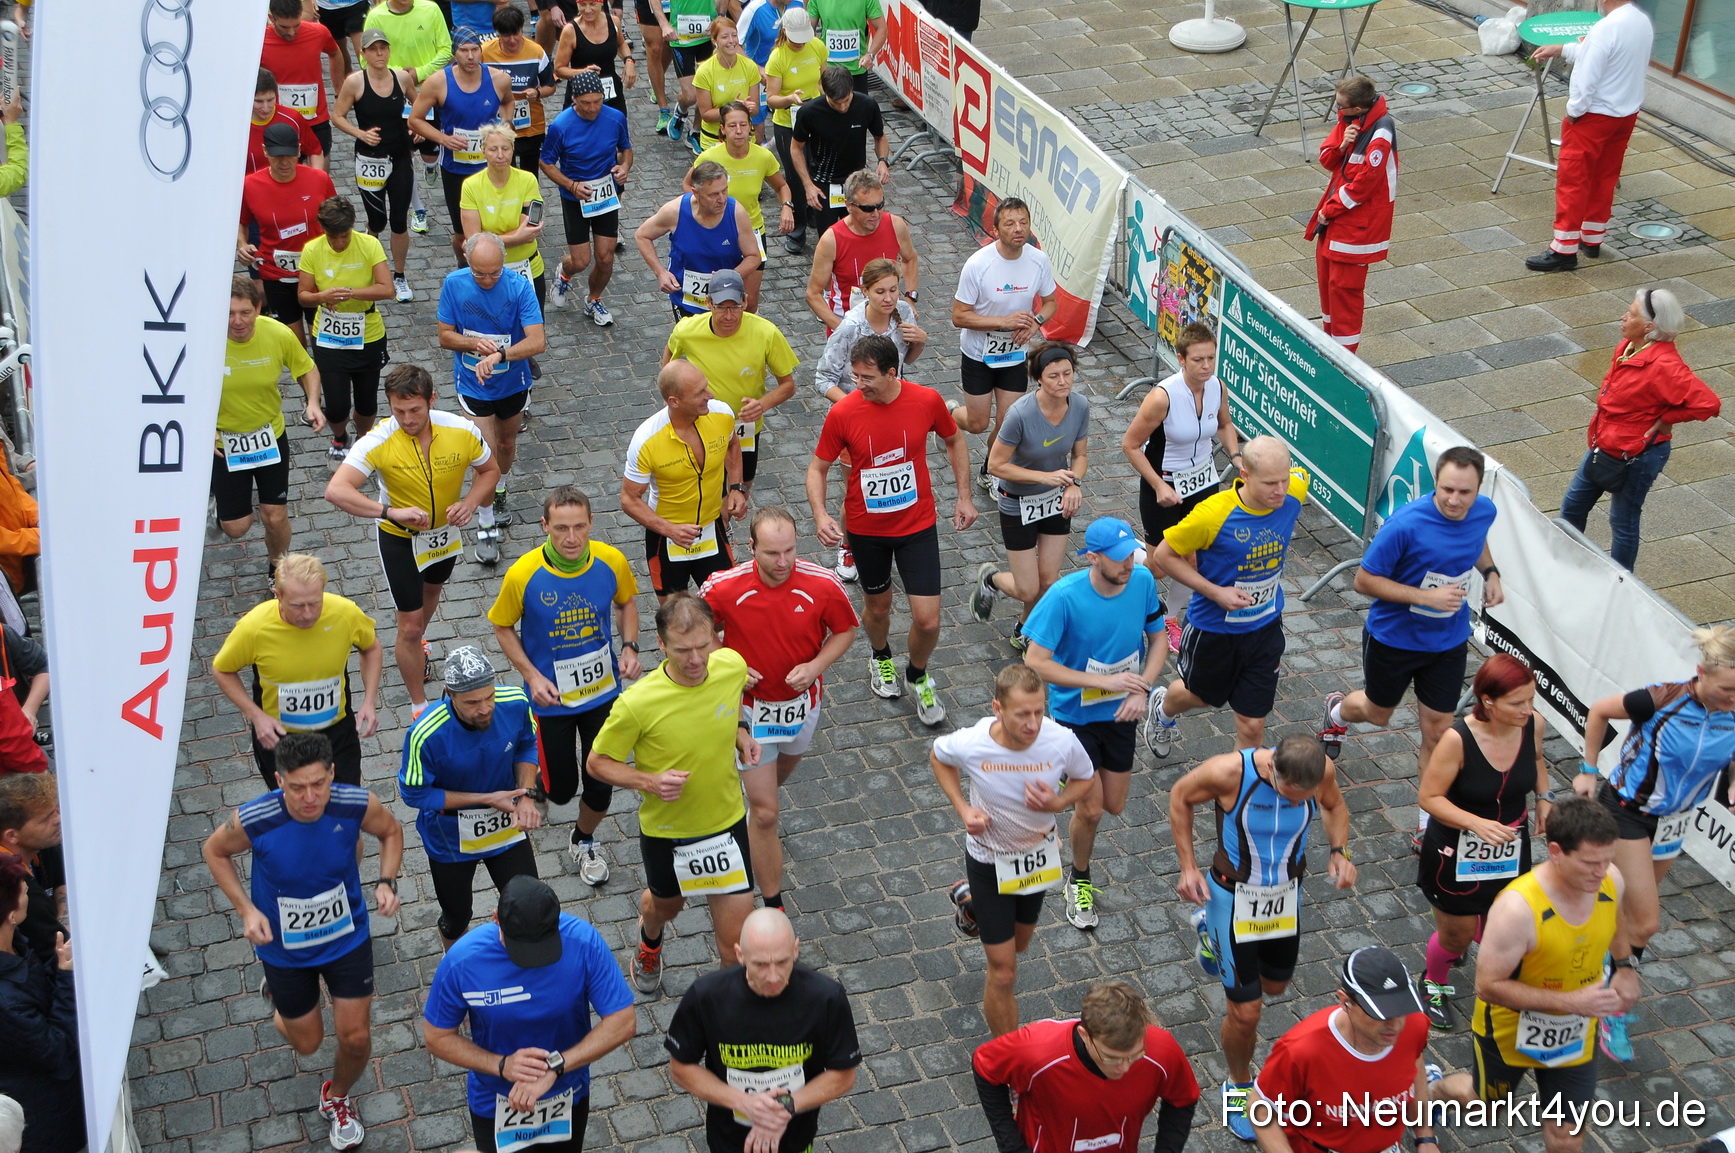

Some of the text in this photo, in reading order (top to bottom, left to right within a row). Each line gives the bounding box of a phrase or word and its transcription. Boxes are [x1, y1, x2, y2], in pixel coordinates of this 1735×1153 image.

[688, 23, 703, 34] 99
[829, 37, 857, 50] 3302
[3, 70, 15, 105] Laufspo
[291, 93, 307, 106] 21
[361, 163, 386, 178] 236
[323, 318, 361, 336] 2655
[1246, 311, 1316, 378] Event-Leit-Systeme
[138, 268, 187, 474] BKK
[1225, 333, 1318, 428] Mehr Sicherheit
[1222, 358, 1299, 441] für Ihr Event!
[228, 431, 271, 453] 2010
[239, 453, 268, 463] Manfred
[879, 468, 905, 478] Neumarkt
[1190, 463, 1208, 477] Neumarkt
[867, 473, 912, 497] 2702
[1179, 467, 1212, 496] 3397
[1038, 491, 1059, 503] Neumarkt
[1312, 478, 1332, 504] 6352
[877, 496, 907, 507] Berthold
[1026, 495, 1064, 521] 2173
[428, 531, 449, 549] 33
[427, 548, 449, 559] Tobias
[121, 517, 182, 741] Audi
[556, 654, 604, 671] PARTL Neumarkt
[1088, 664, 1107, 673] PARTL
[569, 661, 604, 687] 159
[280, 684, 333, 695] PARTL Neumarkt
[579, 685, 600, 697] Klaus
[286, 690, 335, 713] 3401
[1533, 669, 1549, 690] die
[1550, 684, 1588, 730] verbind
[758, 703, 806, 724] 2164
[767, 726, 797, 737] Marcus
[980, 760, 1043, 773] Continental
[473, 812, 512, 838] 638
[696, 842, 728, 855] Neumarkt
[1464, 840, 1516, 860] 2505
[688, 851, 730, 877] 606
[1009, 848, 1048, 876] 165
[1470, 863, 1505, 873] Susanne
[1018, 873, 1043, 888] Albert
[280, 902, 301, 911] PARTL
[287, 900, 344, 930] 2220
[1248, 895, 1285, 918] 140
[304, 928, 334, 941] Stefan
[1248, 921, 1280, 933] Thomas
[1525, 1021, 1584, 1048] 2802
[754, 1071, 791, 1085] Neumarkt
[503, 1100, 567, 1128] 2212
[514, 1124, 551, 1141] Norbert
